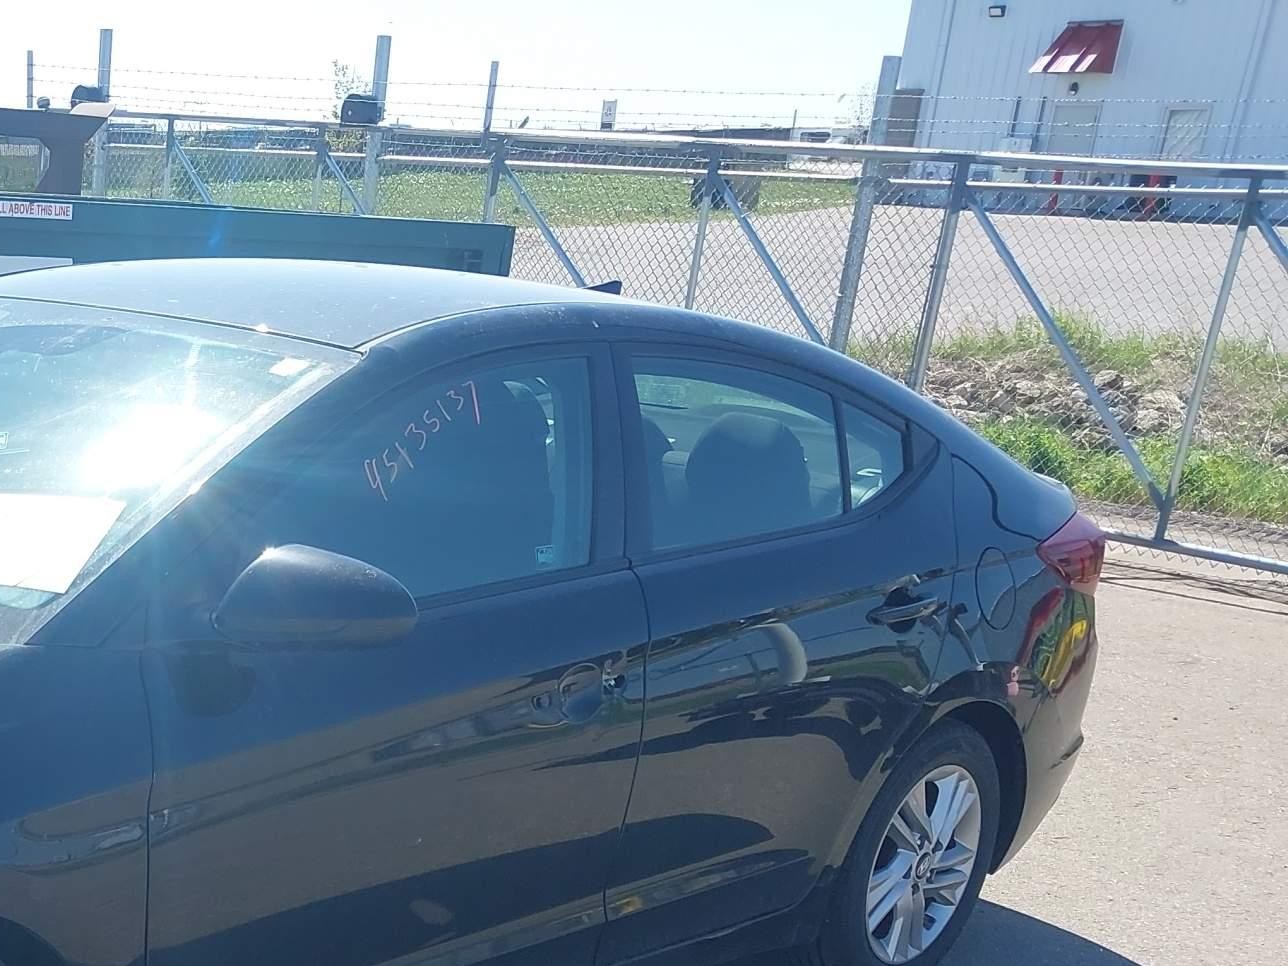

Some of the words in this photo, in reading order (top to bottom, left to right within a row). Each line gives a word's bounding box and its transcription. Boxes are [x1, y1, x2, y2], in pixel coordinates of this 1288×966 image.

[9, 203, 34, 215] ABOVE
[37, 204, 52, 215] THIS
[55, 205, 70, 216] LINE
[364, 380, 480, 501] 45135137
